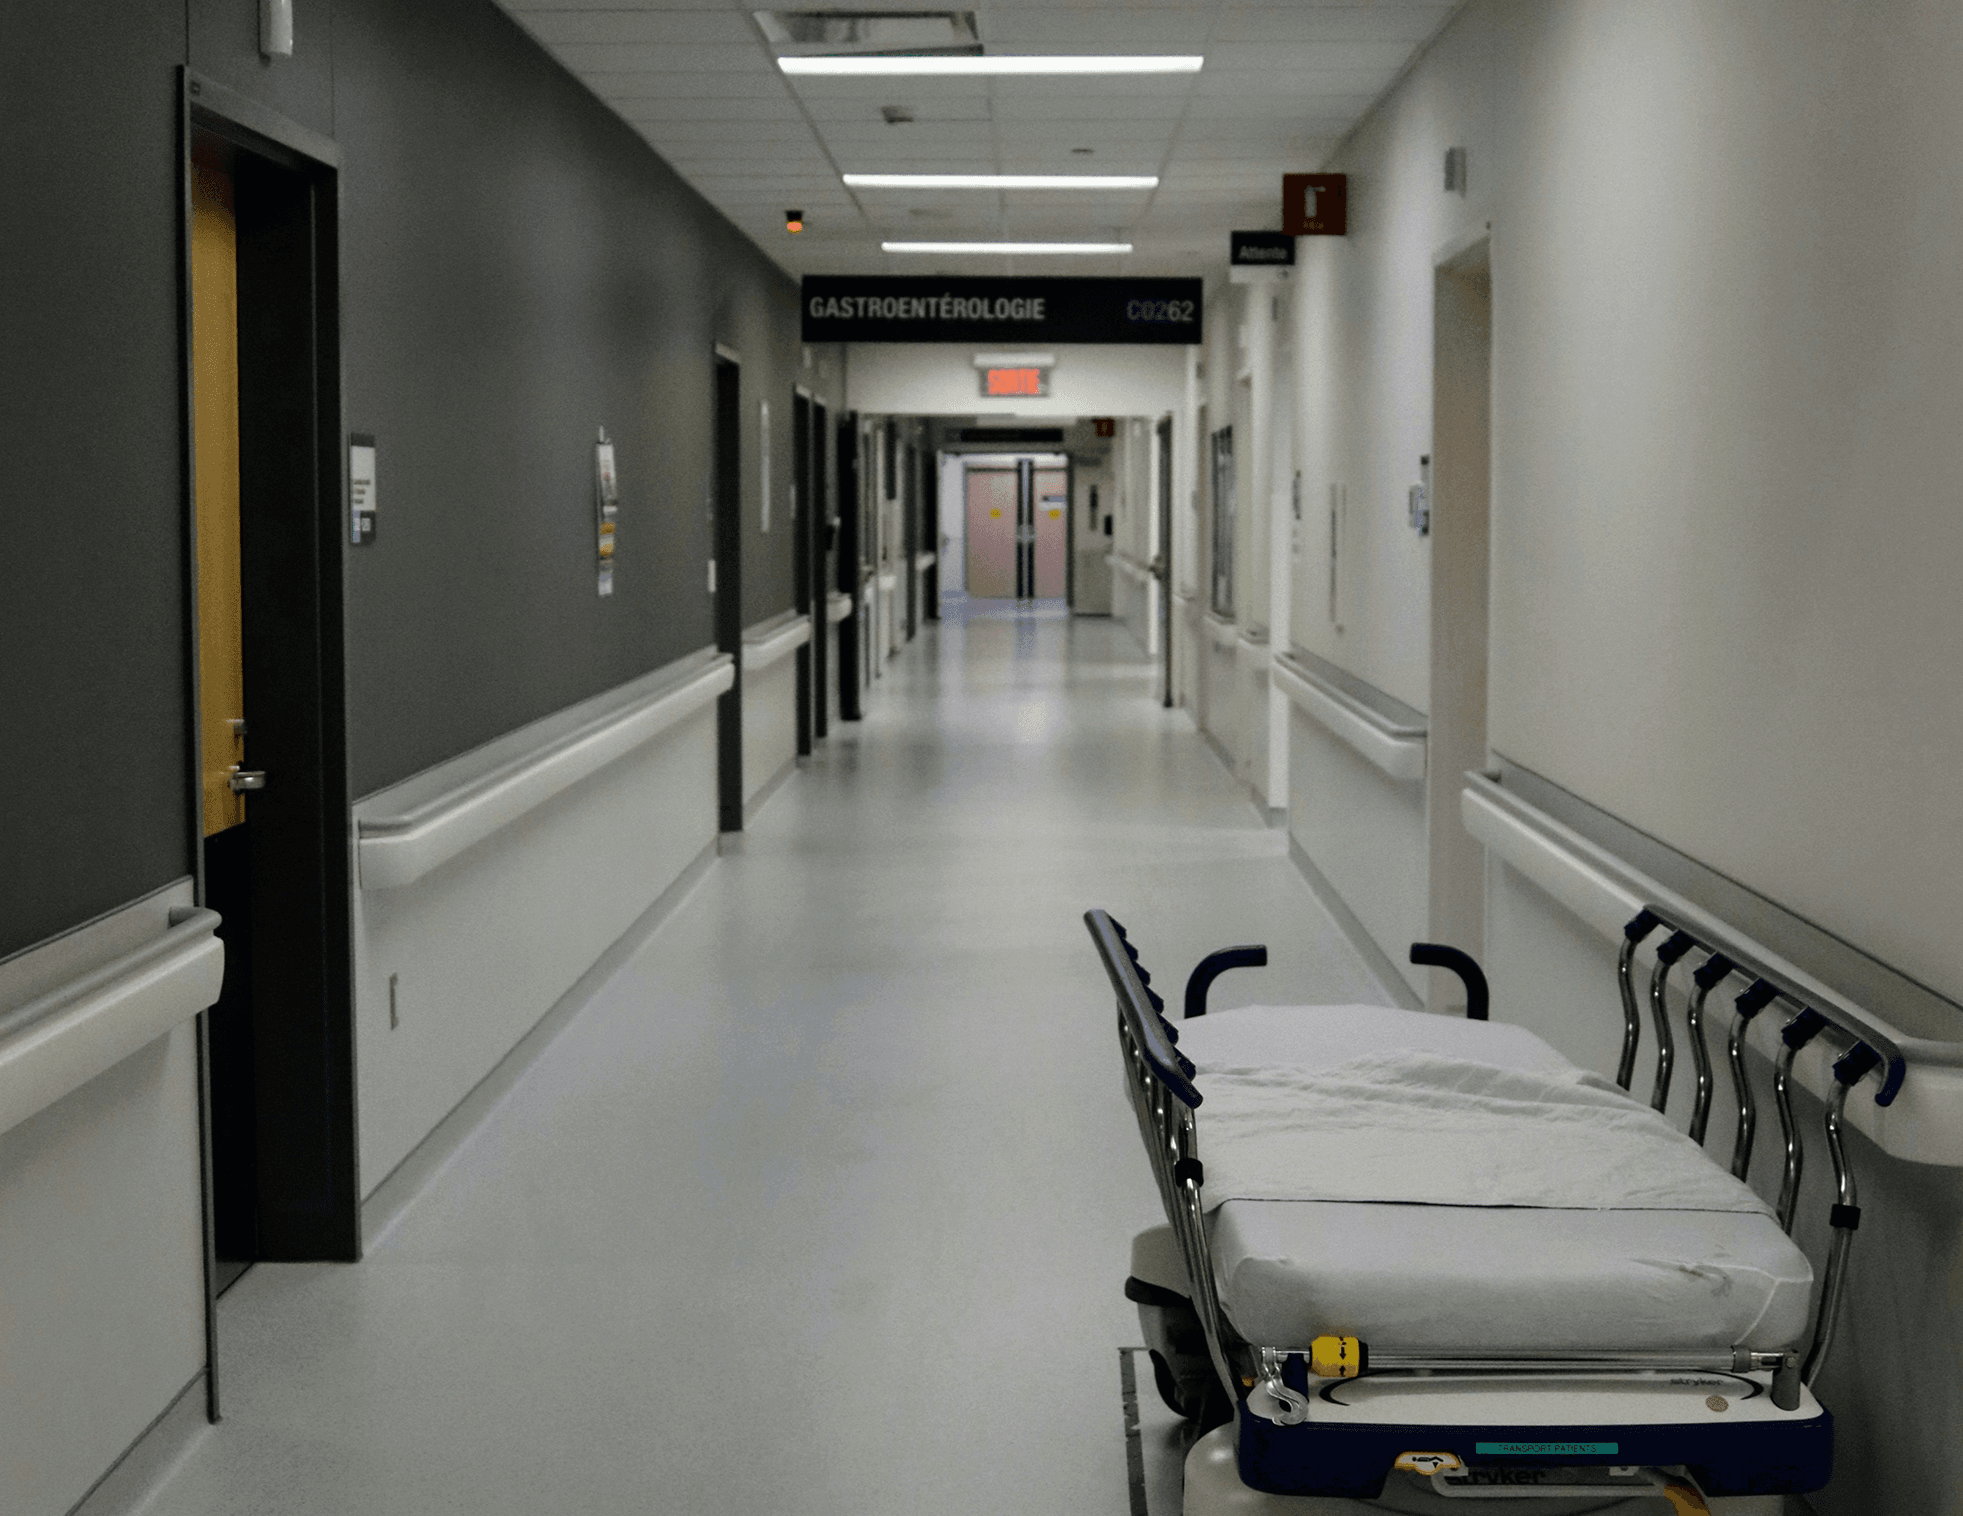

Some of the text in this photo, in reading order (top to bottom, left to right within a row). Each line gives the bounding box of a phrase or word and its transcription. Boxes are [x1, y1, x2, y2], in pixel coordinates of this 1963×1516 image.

[808, 292, 1045, 320] GASTROENTÉROLOGIE
[1498, 1444, 1597, 1453] TRANSPORT PATIENTS
